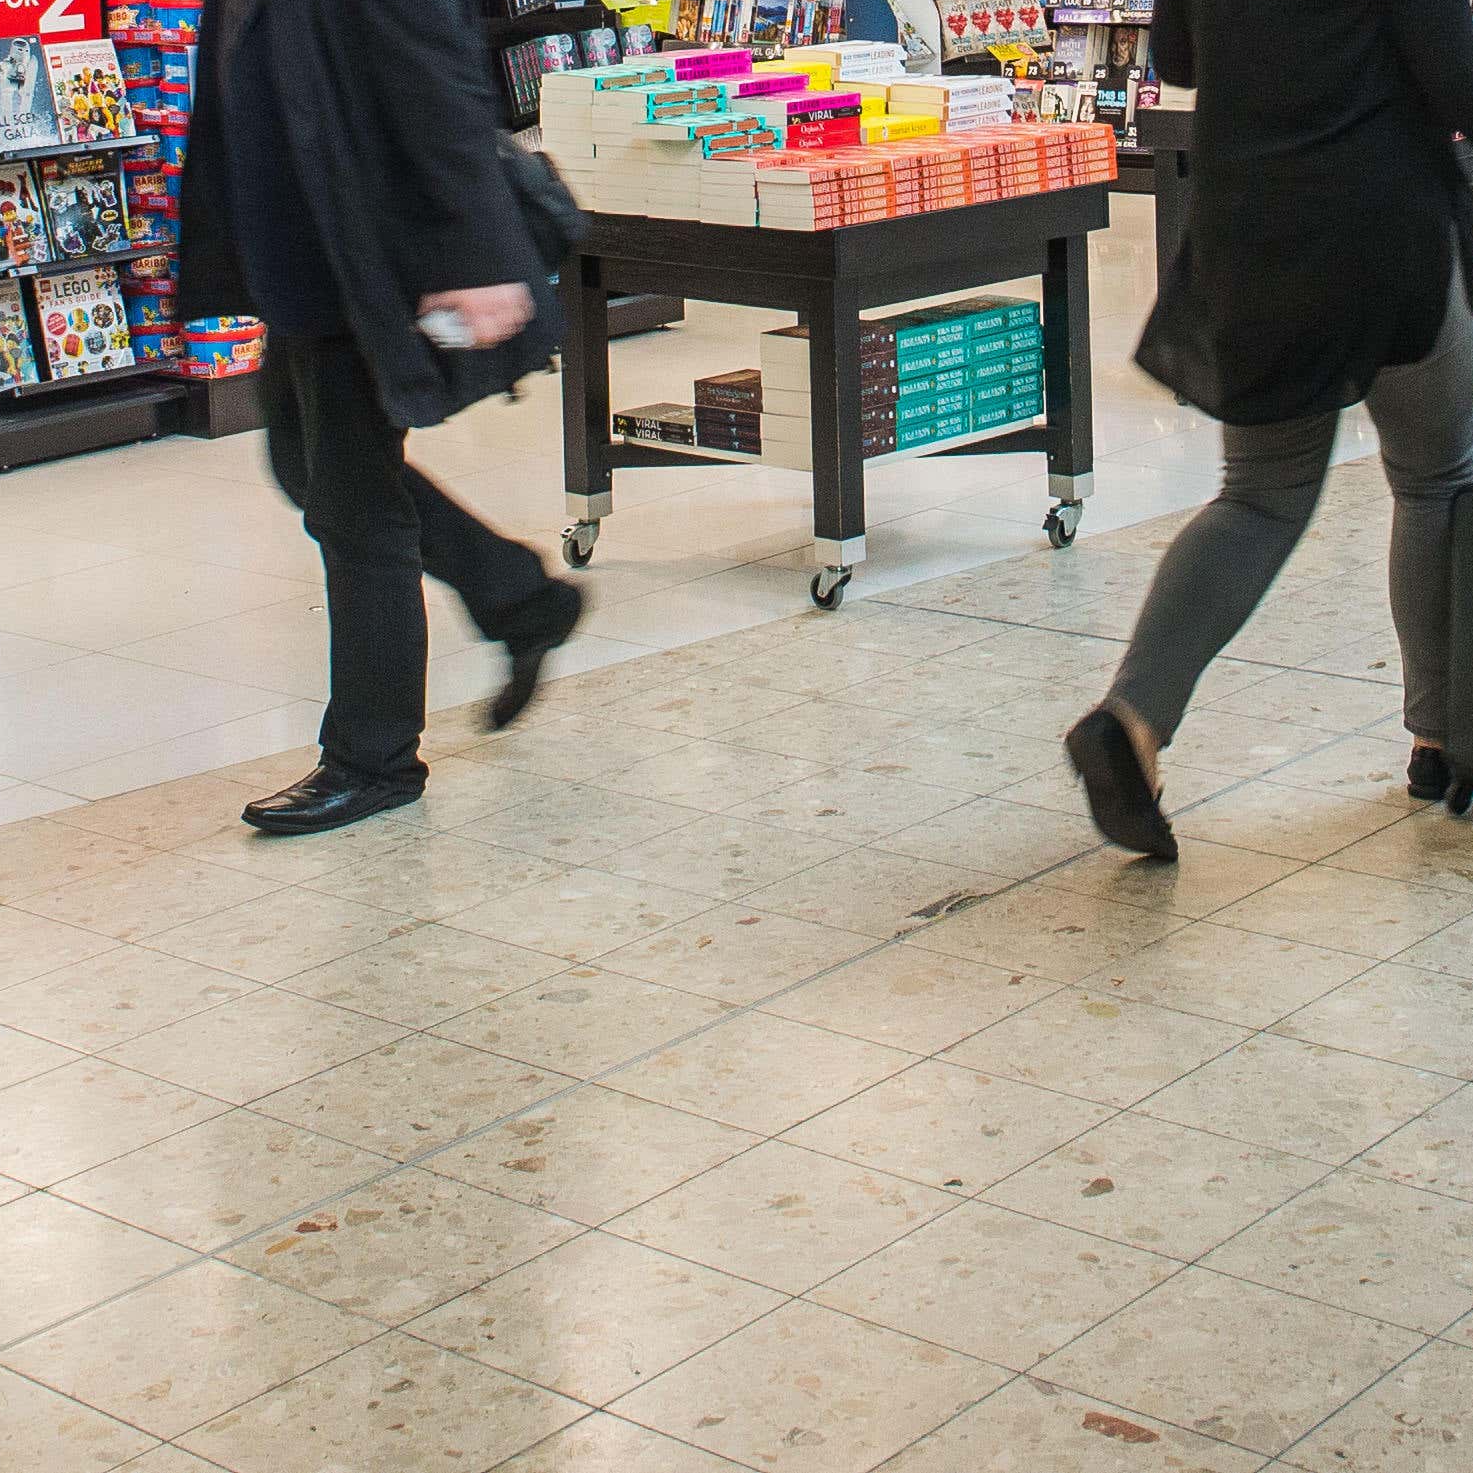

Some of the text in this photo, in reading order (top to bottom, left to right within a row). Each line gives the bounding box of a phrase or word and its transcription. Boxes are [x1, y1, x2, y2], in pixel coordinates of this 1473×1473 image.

[871, 50, 895, 61] LEADING
[977, 83, 1003, 95] LEADING
[808, 108, 834, 122] VIRAL
[132, 259, 167, 269] HARIBO
[54, 279, 90, 298] LEGO
[76, 292, 102, 303] GUIDE
[635, 418, 662, 431] VIRAL
